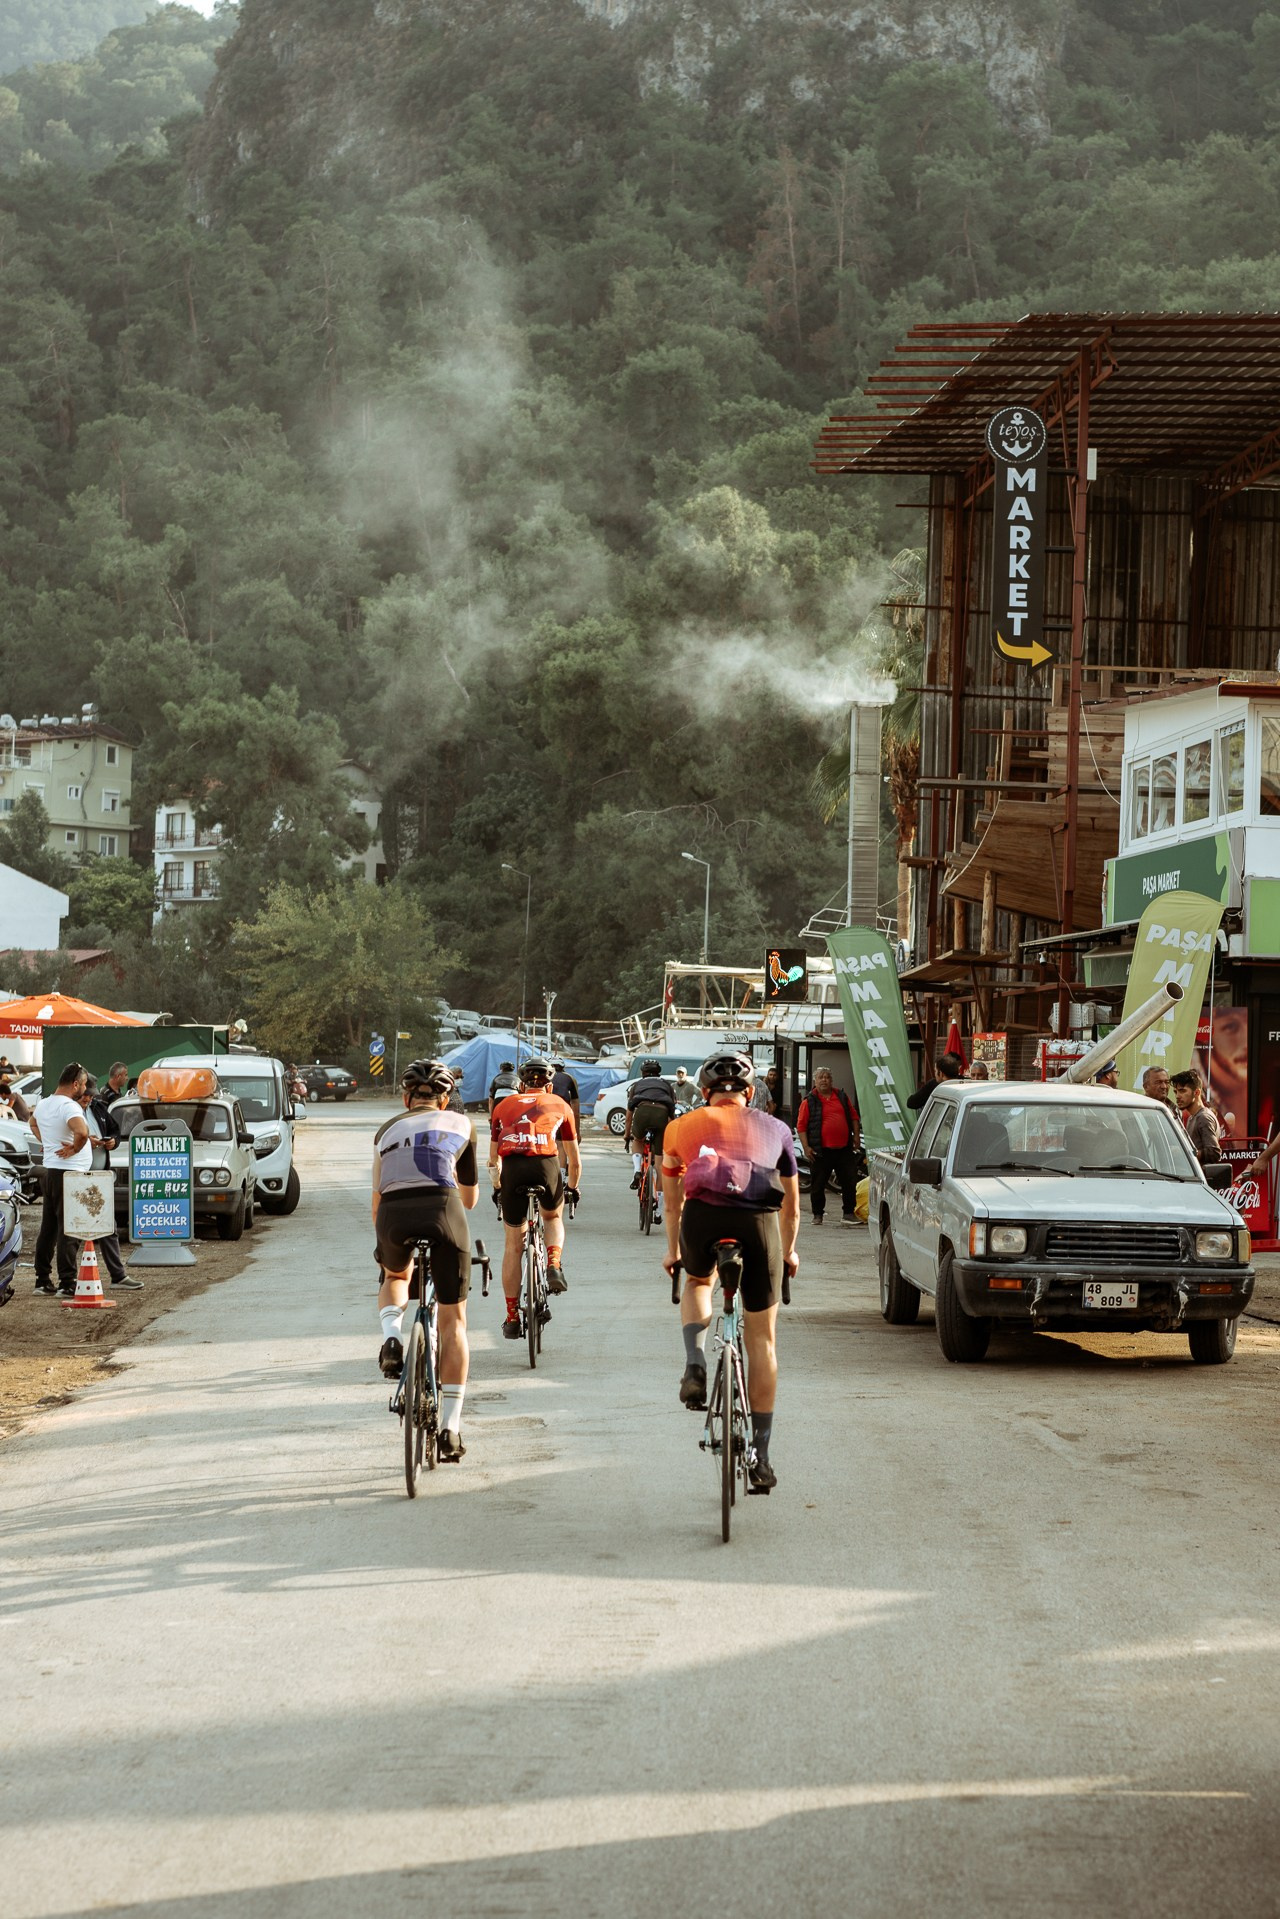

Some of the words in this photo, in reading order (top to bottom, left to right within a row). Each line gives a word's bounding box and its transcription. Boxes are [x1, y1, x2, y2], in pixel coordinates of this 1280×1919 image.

[1006, 467, 1036, 636] MARKET
[1142, 875, 1157, 899] PAŞA
[1157, 869, 1181, 892] MARKET
[1145, 924, 1211, 956] PAŞA
[9, 1024, 42, 1034] TADINI
[135, 1136, 187, 1153] MARKET
[134, 1157, 156, 1167] FREE
[158, 1156, 188, 1167] YACHT
[1229, 1151, 1261, 1160] MARKET
[140, 1169, 182, 1179] SERVICES
[135, 1182, 155, 1196] ICE
[164, 1182, 188, 1195] BUZ
[142, 1202, 180, 1214] SOĞUK
[135, 1214, 187, 1229] İÇECEKLER
[1087, 1284, 1102, 1294] 48
[1121, 1284, 1136, 1295] JL
[1100, 1296, 1123, 1306] 809
